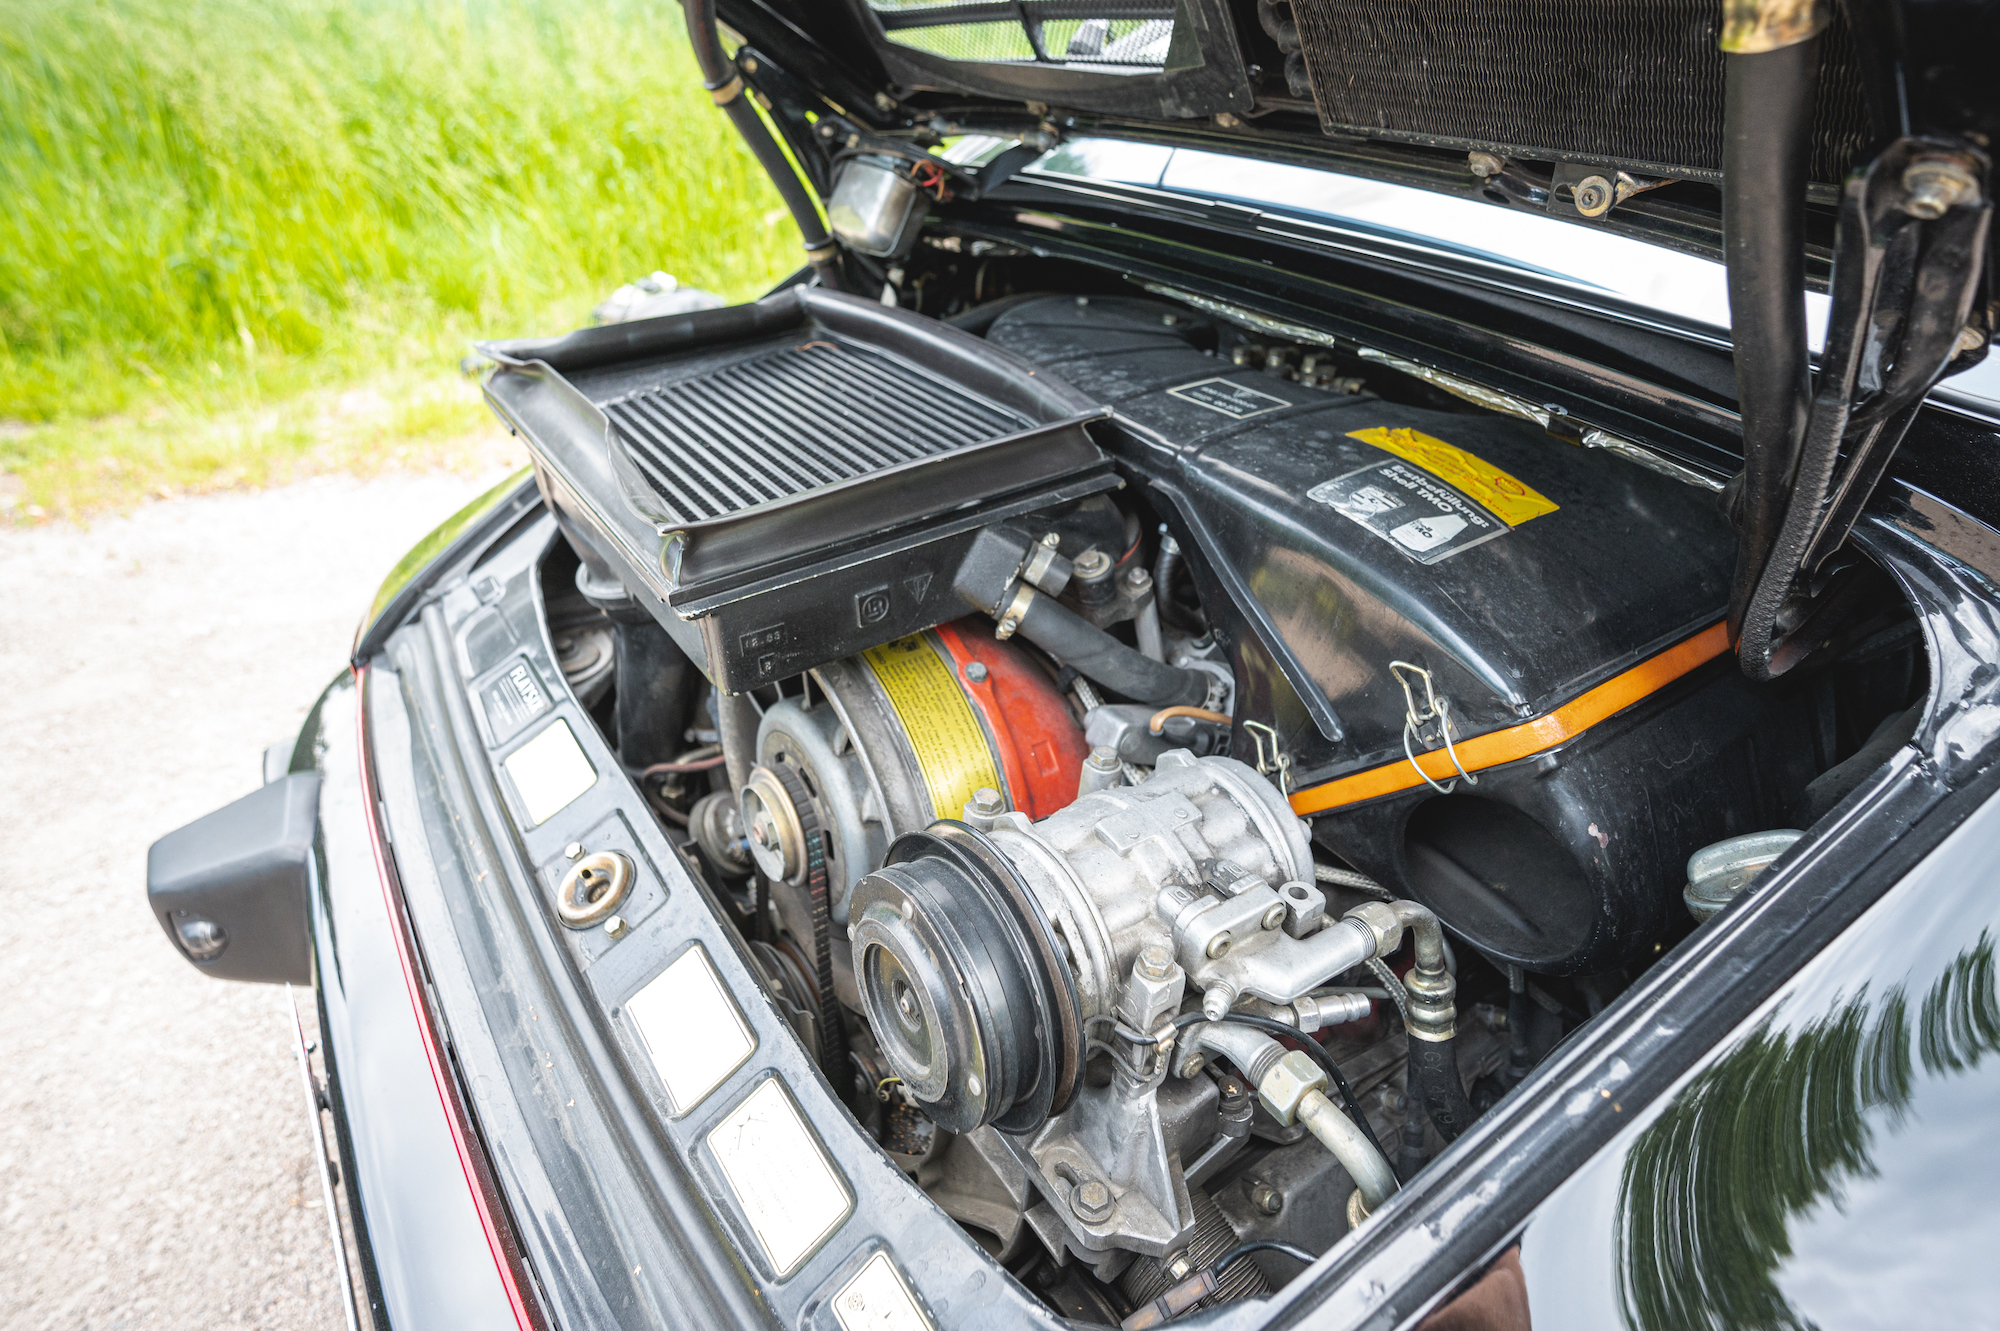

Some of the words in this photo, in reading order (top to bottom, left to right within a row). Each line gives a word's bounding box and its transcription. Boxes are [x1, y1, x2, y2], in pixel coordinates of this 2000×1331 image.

[1379, 468, 1418, 490] Shell
[1416, 485, 1453, 513] TMO
[1390, 465, 1490, 529] Erstbefüllung:
[1423, 1051, 1443, 1073] GY
